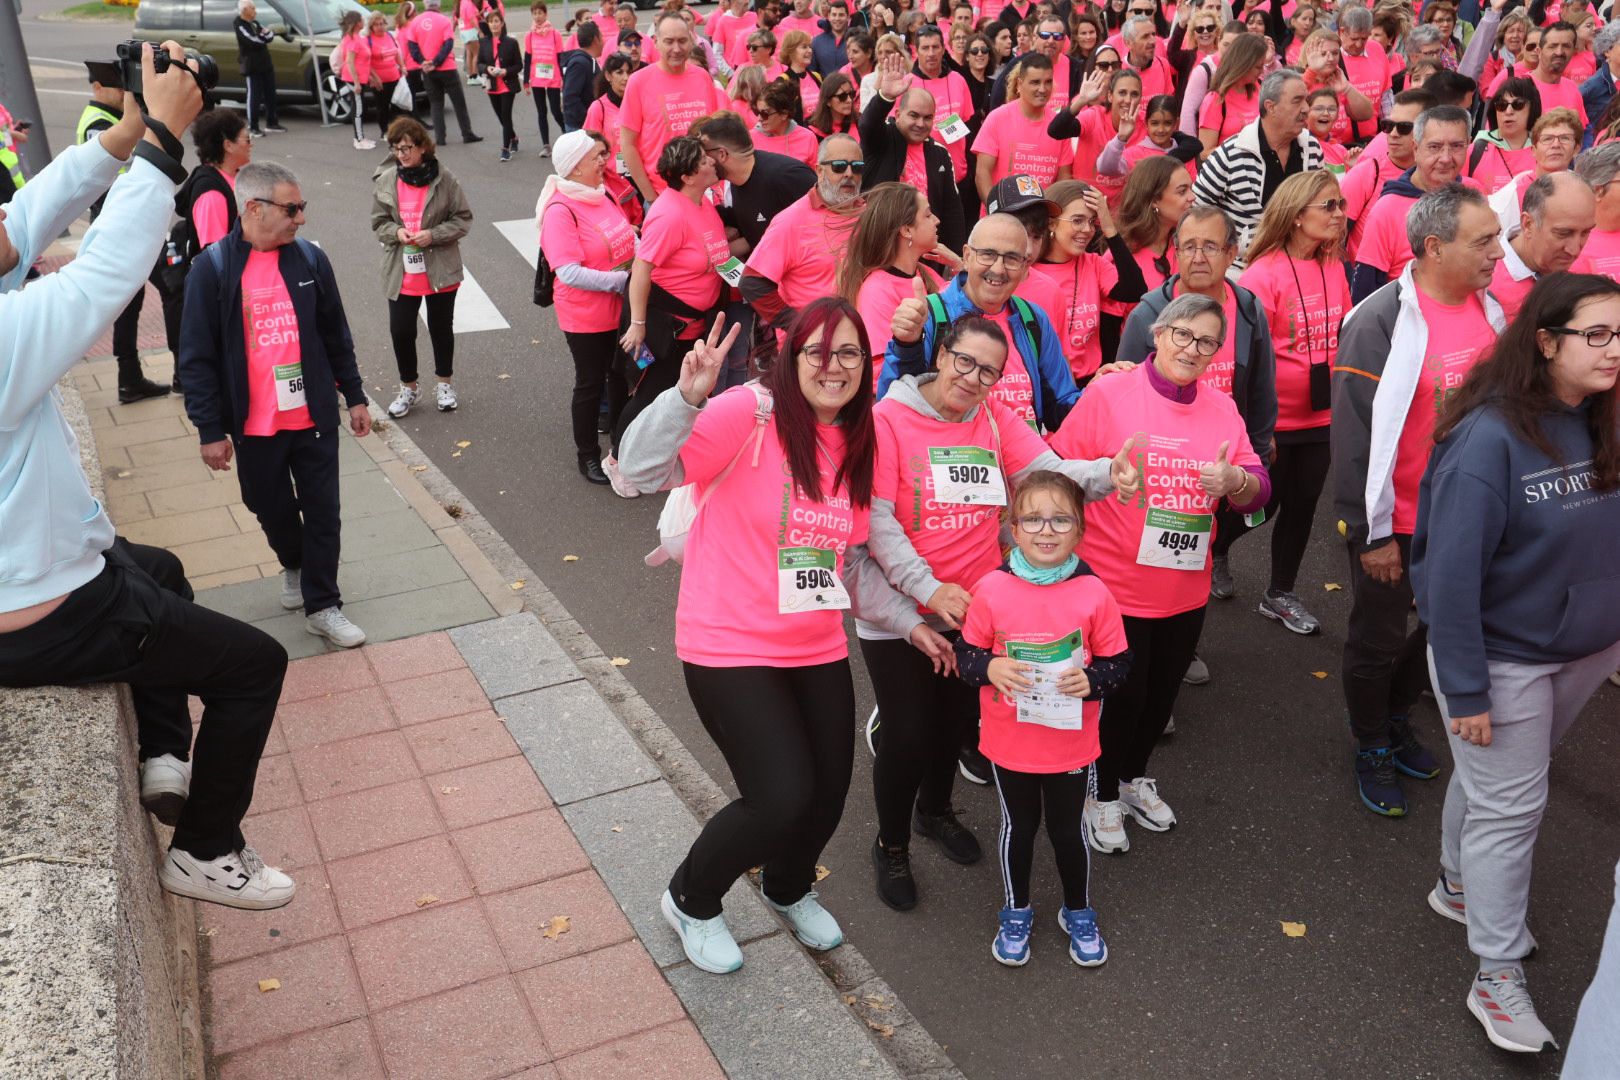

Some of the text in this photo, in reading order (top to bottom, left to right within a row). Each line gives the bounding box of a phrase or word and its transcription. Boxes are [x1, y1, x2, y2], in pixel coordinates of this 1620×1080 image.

[669, 110, 698, 121] contra
[1015, 151, 1058, 164] En marcha
[1013, 163, 1056, 174] contra el
[407, 254, 424, 264] 569
[253, 303, 270, 315] En
[1297, 311, 1312, 323] En
[255, 313, 297, 330] contr
[1296, 336, 1338, 354] cánc
[1445, 371, 1464, 387] En
[1147, 452, 1168, 468] En
[948, 465, 990, 485] 5902
[1562, 501, 1581, 511] NEW
[788, 526, 848, 556] cánce
[1158, 530, 1199, 551] 4994
[796, 568, 835, 590] 5903
